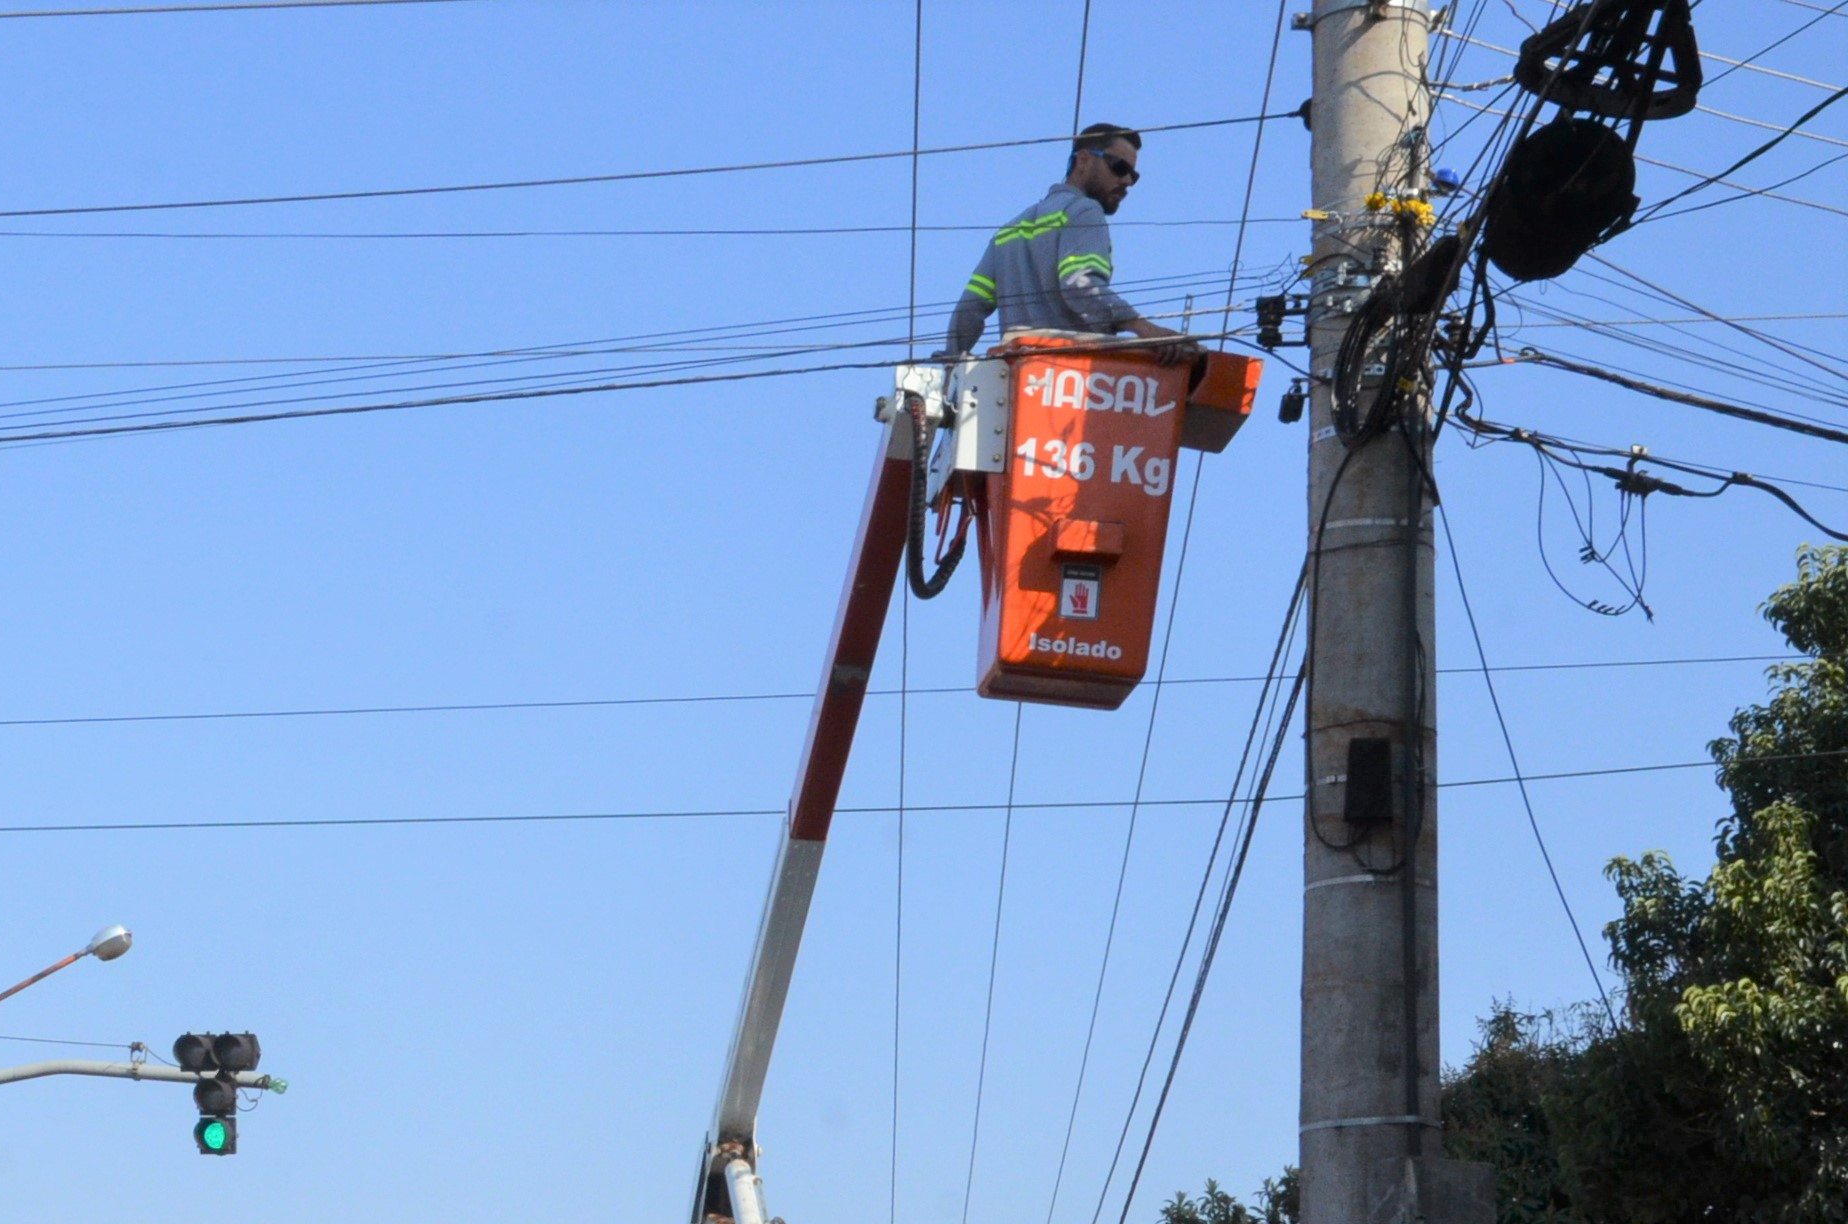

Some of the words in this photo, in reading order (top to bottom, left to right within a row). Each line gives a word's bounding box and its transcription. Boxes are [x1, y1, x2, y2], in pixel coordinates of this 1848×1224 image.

[1017, 438, 1095, 482] 136
[1110, 445, 1171, 497] Kg
[1028, 632, 1122, 660] Isolado
